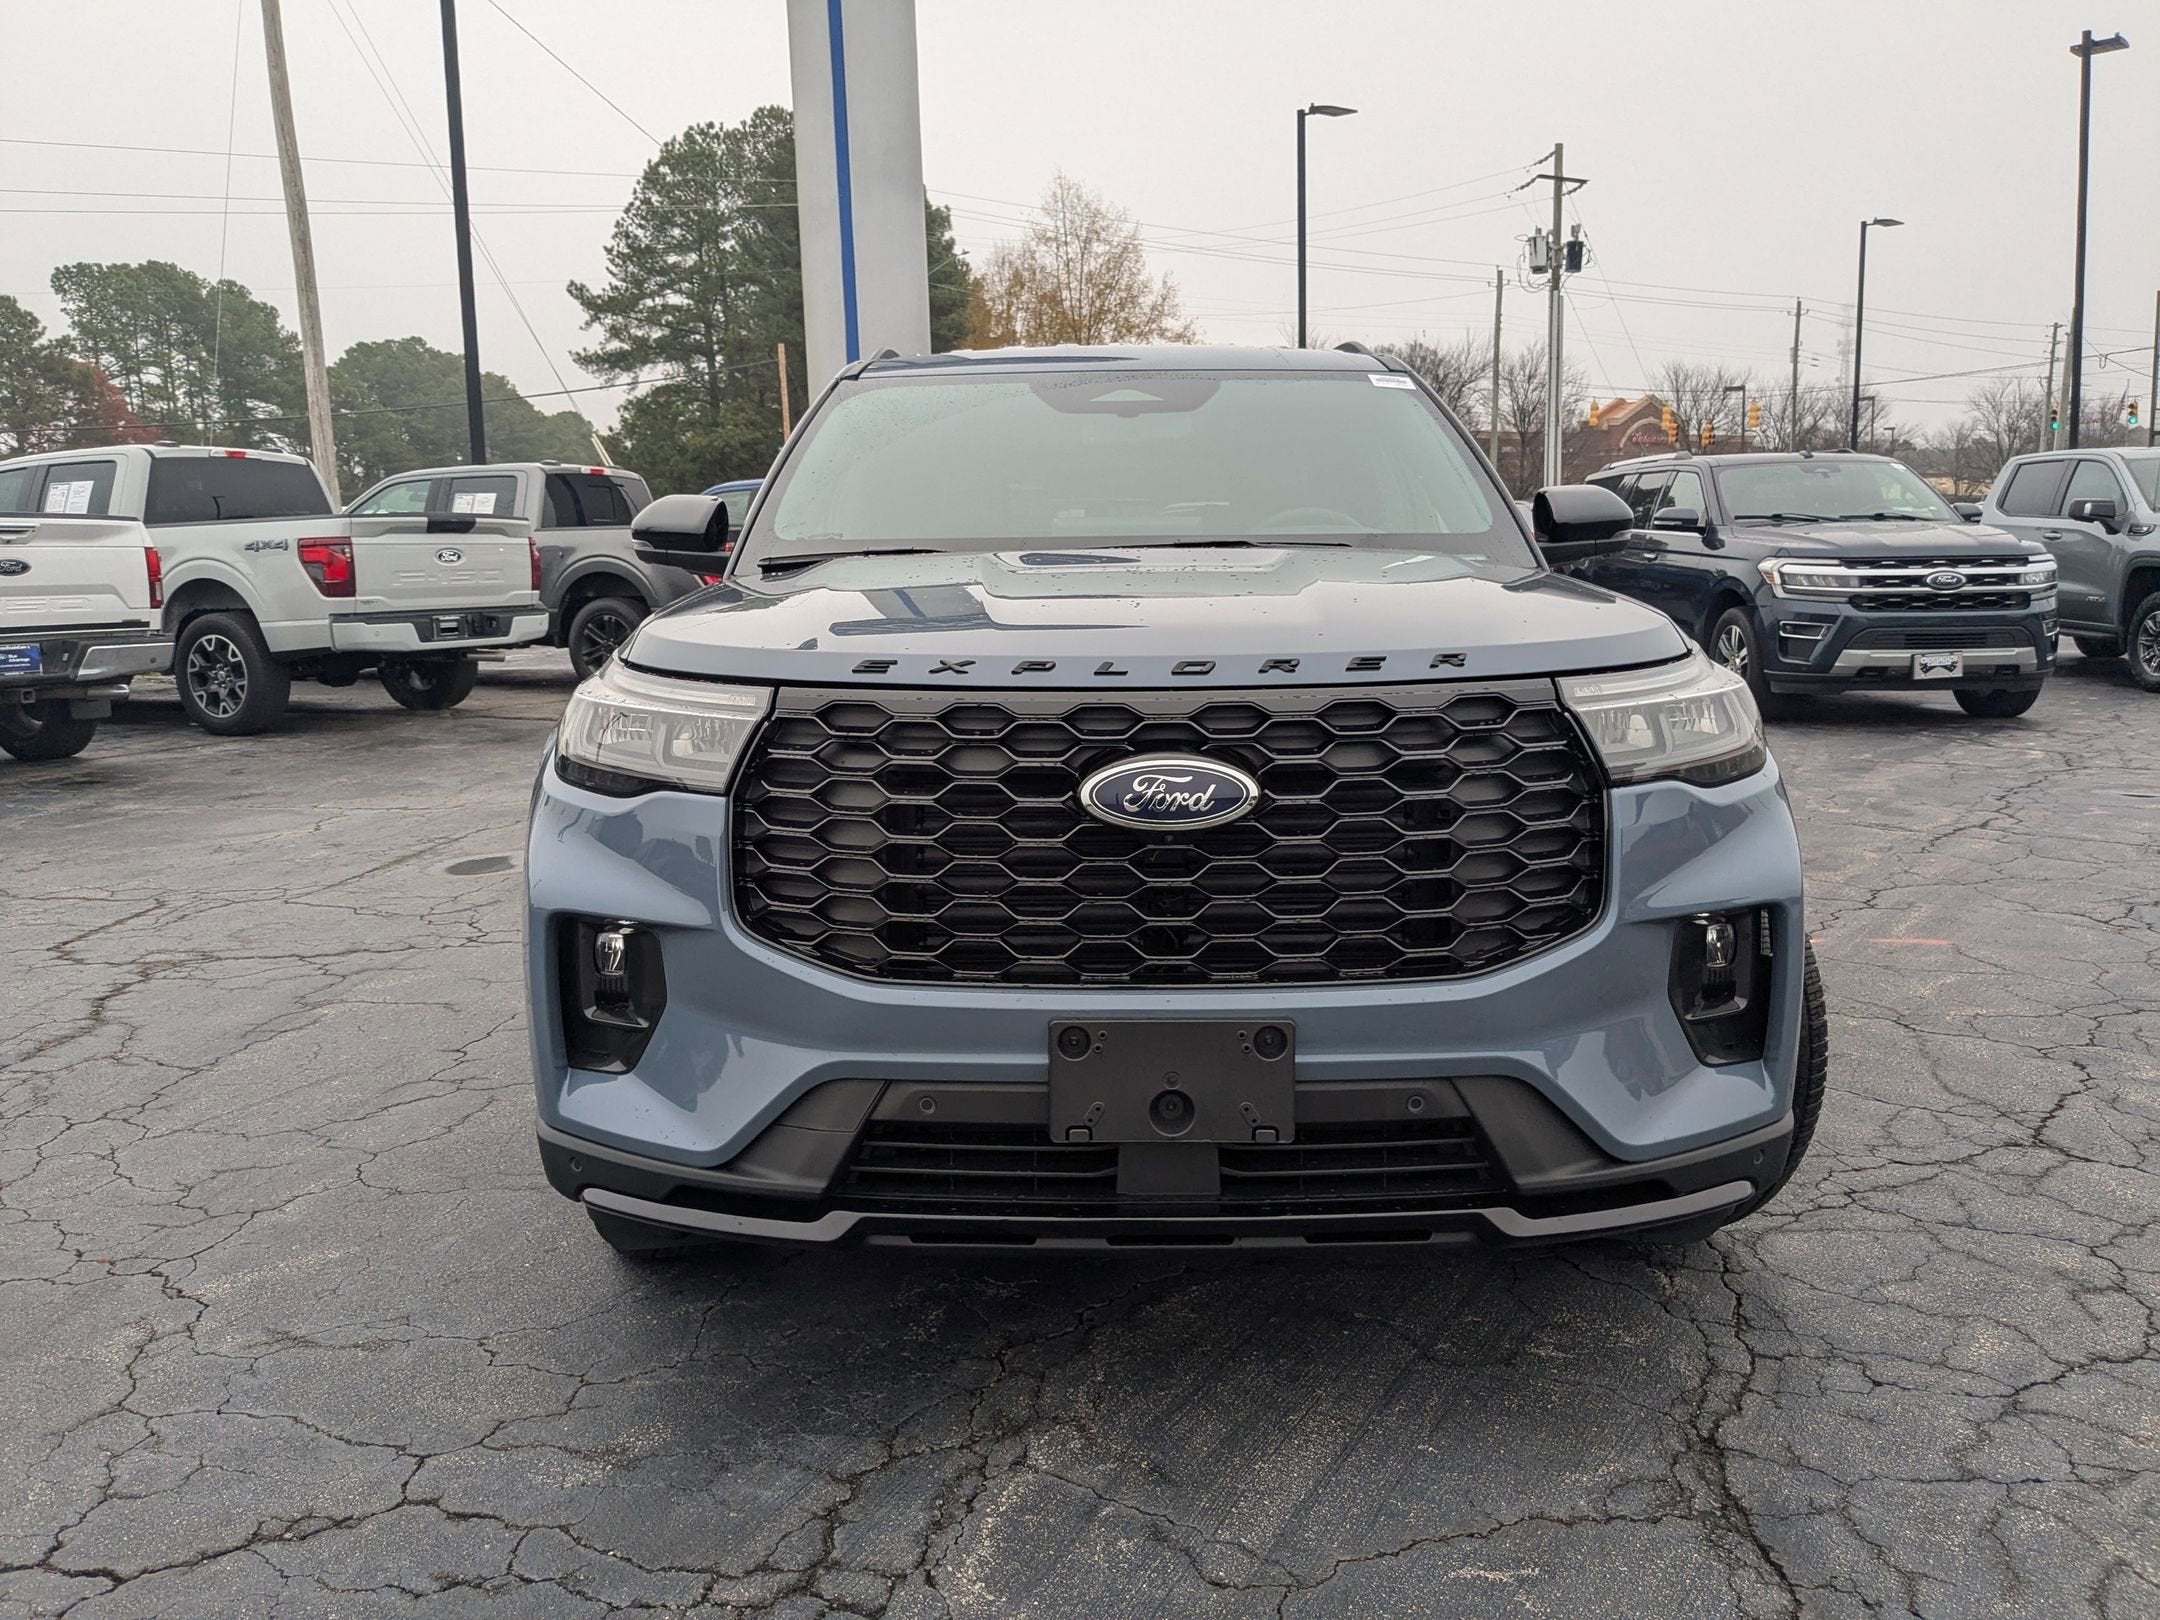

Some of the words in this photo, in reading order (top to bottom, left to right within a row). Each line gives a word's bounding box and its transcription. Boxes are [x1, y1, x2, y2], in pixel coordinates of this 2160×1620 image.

[0, 561, 23, 572] Ford
[1935, 575, 1958, 584] Ford
[851, 653, 1467, 676] EXPLORER
[1123, 774, 1217, 812] Ford
